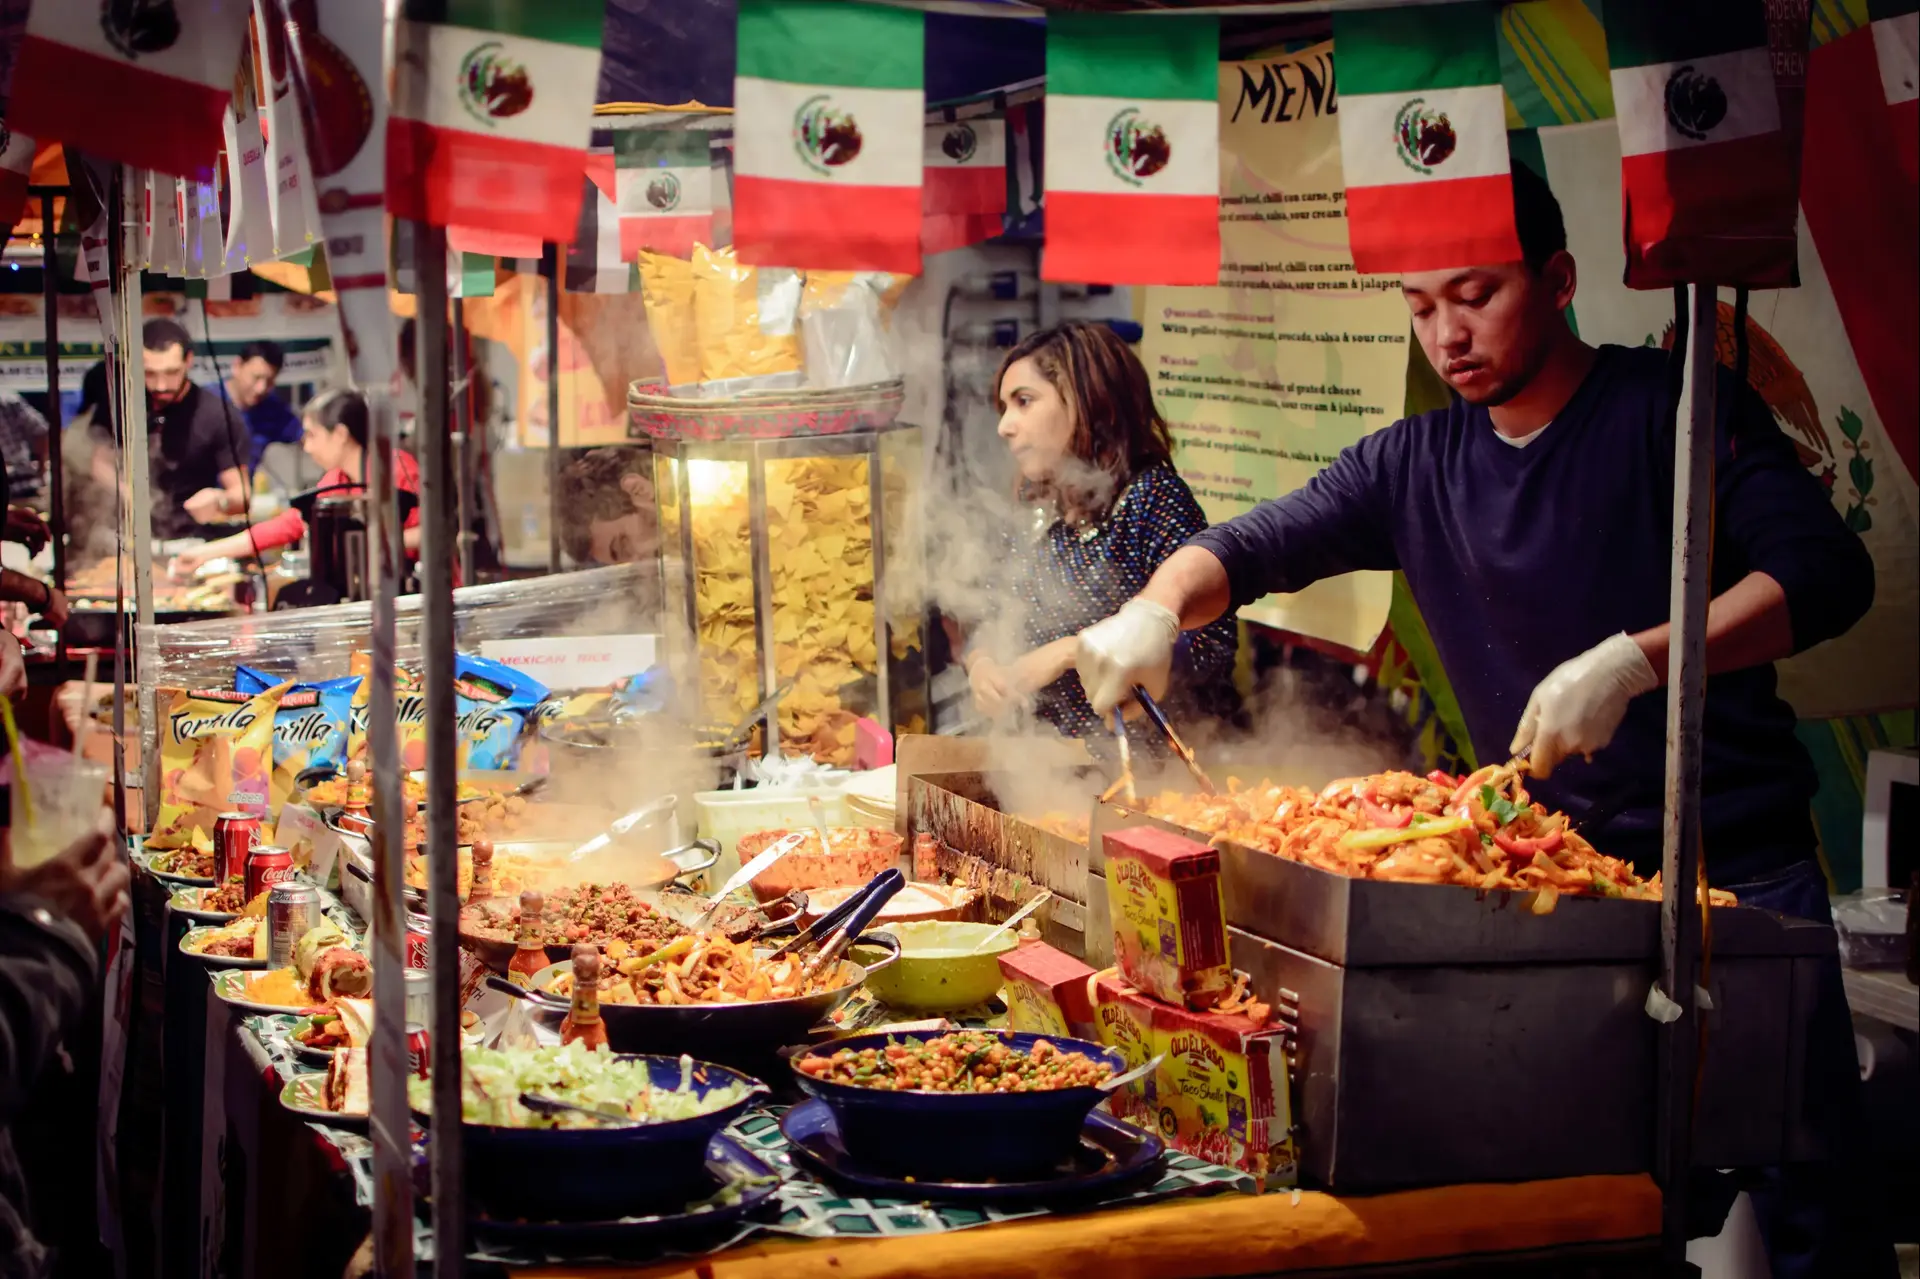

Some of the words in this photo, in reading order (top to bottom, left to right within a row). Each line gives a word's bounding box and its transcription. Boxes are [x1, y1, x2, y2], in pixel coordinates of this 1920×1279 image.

[1312, 209, 1341, 218] cream
[1296, 281, 1315, 289] sour
[1317, 280, 1348, 289] cream
[1342, 332, 1349, 342] &
[1352, 334, 1375, 343] sour
[1158, 370, 1202, 382] Mexican
[1327, 385, 1361, 395] cheese
[1157, 387, 1186, 397] chilli
[1300, 402, 1328, 411] cream
[1330, 402, 1337, 411] &
[500, 653, 567, 666] MEXICAN
[576, 653, 612, 663] RICE
[281, 692, 315, 706] EQUITO
[1171, 1036, 1189, 1058] OLD
[1188, 1033, 1203, 1054] EL
[1178, 1078, 1200, 1096] Taco
[1200, 1083, 1224, 1103] Shells
